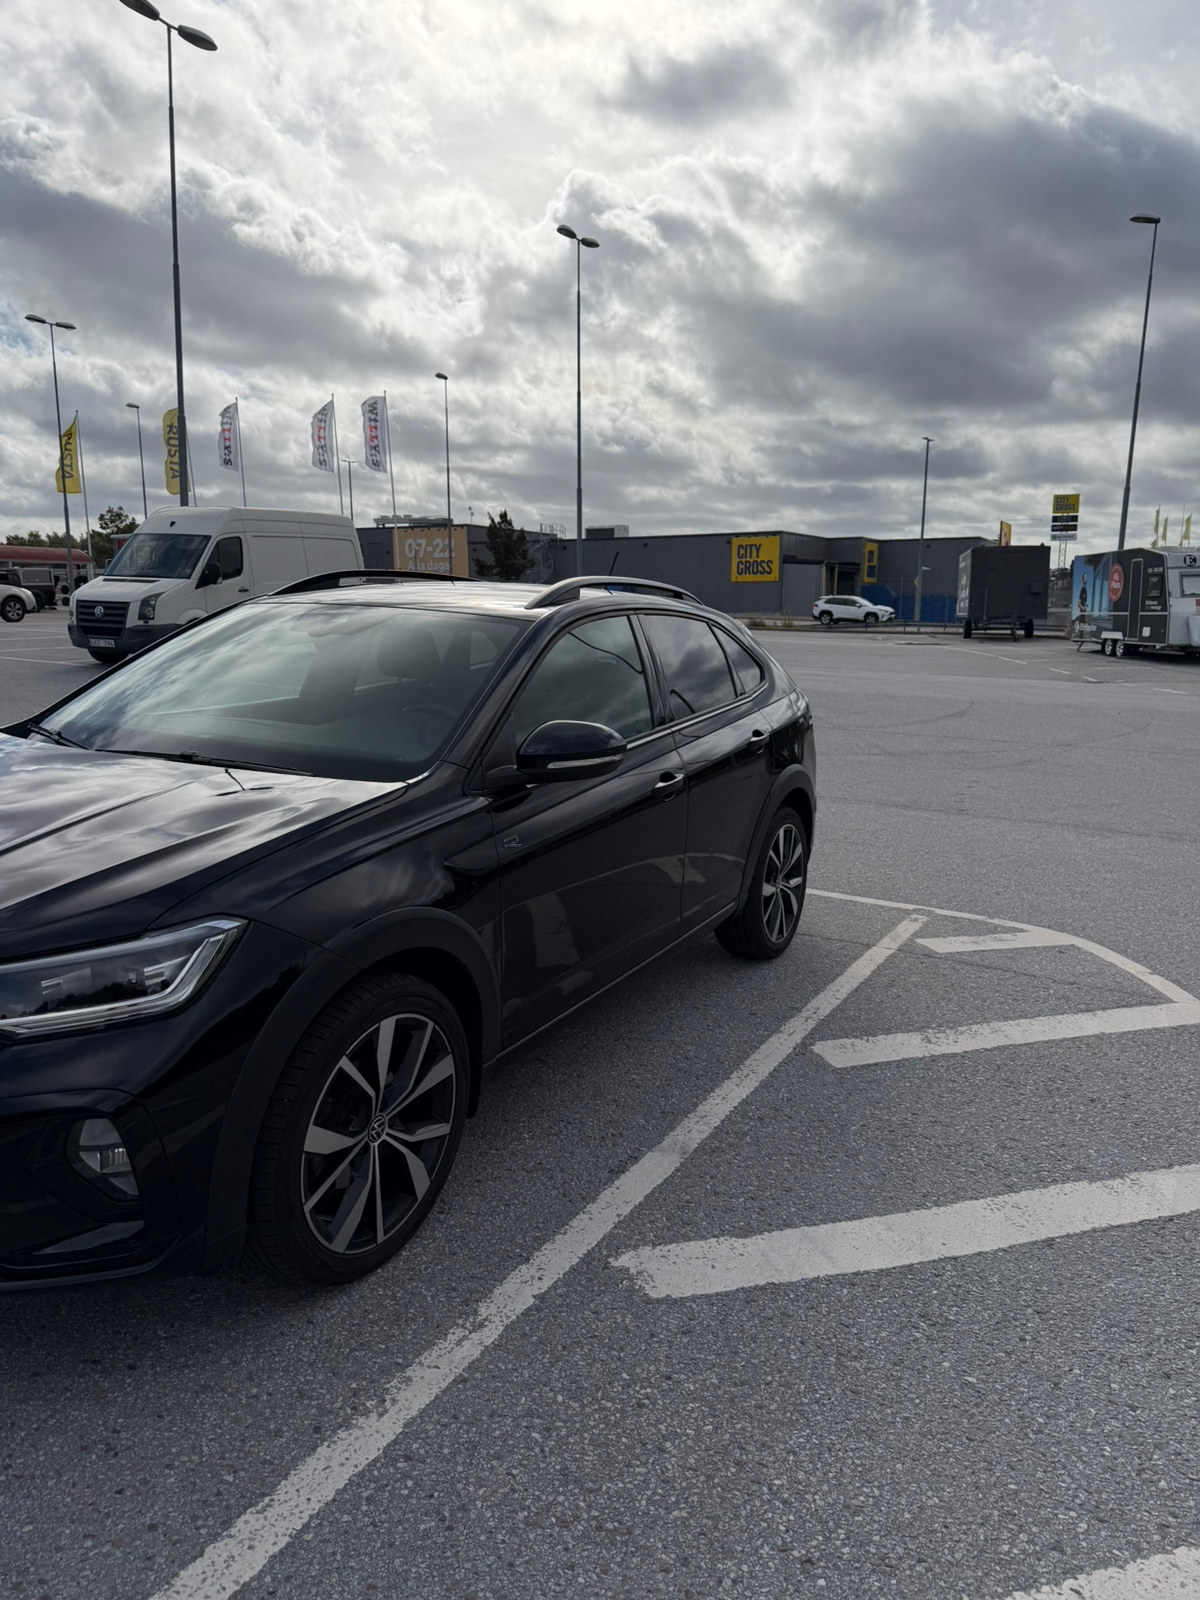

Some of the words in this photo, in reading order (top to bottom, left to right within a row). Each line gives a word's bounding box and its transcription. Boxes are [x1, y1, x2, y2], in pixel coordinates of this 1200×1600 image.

[61, 432, 74, 479] RUSTA
[404, 538, 455, 559] 07-22
[737, 543, 762, 560] CITY
[407, 560, 425, 571] Ala
[427, 560, 452, 572] daga
[736, 559, 773, 576] GROSS
